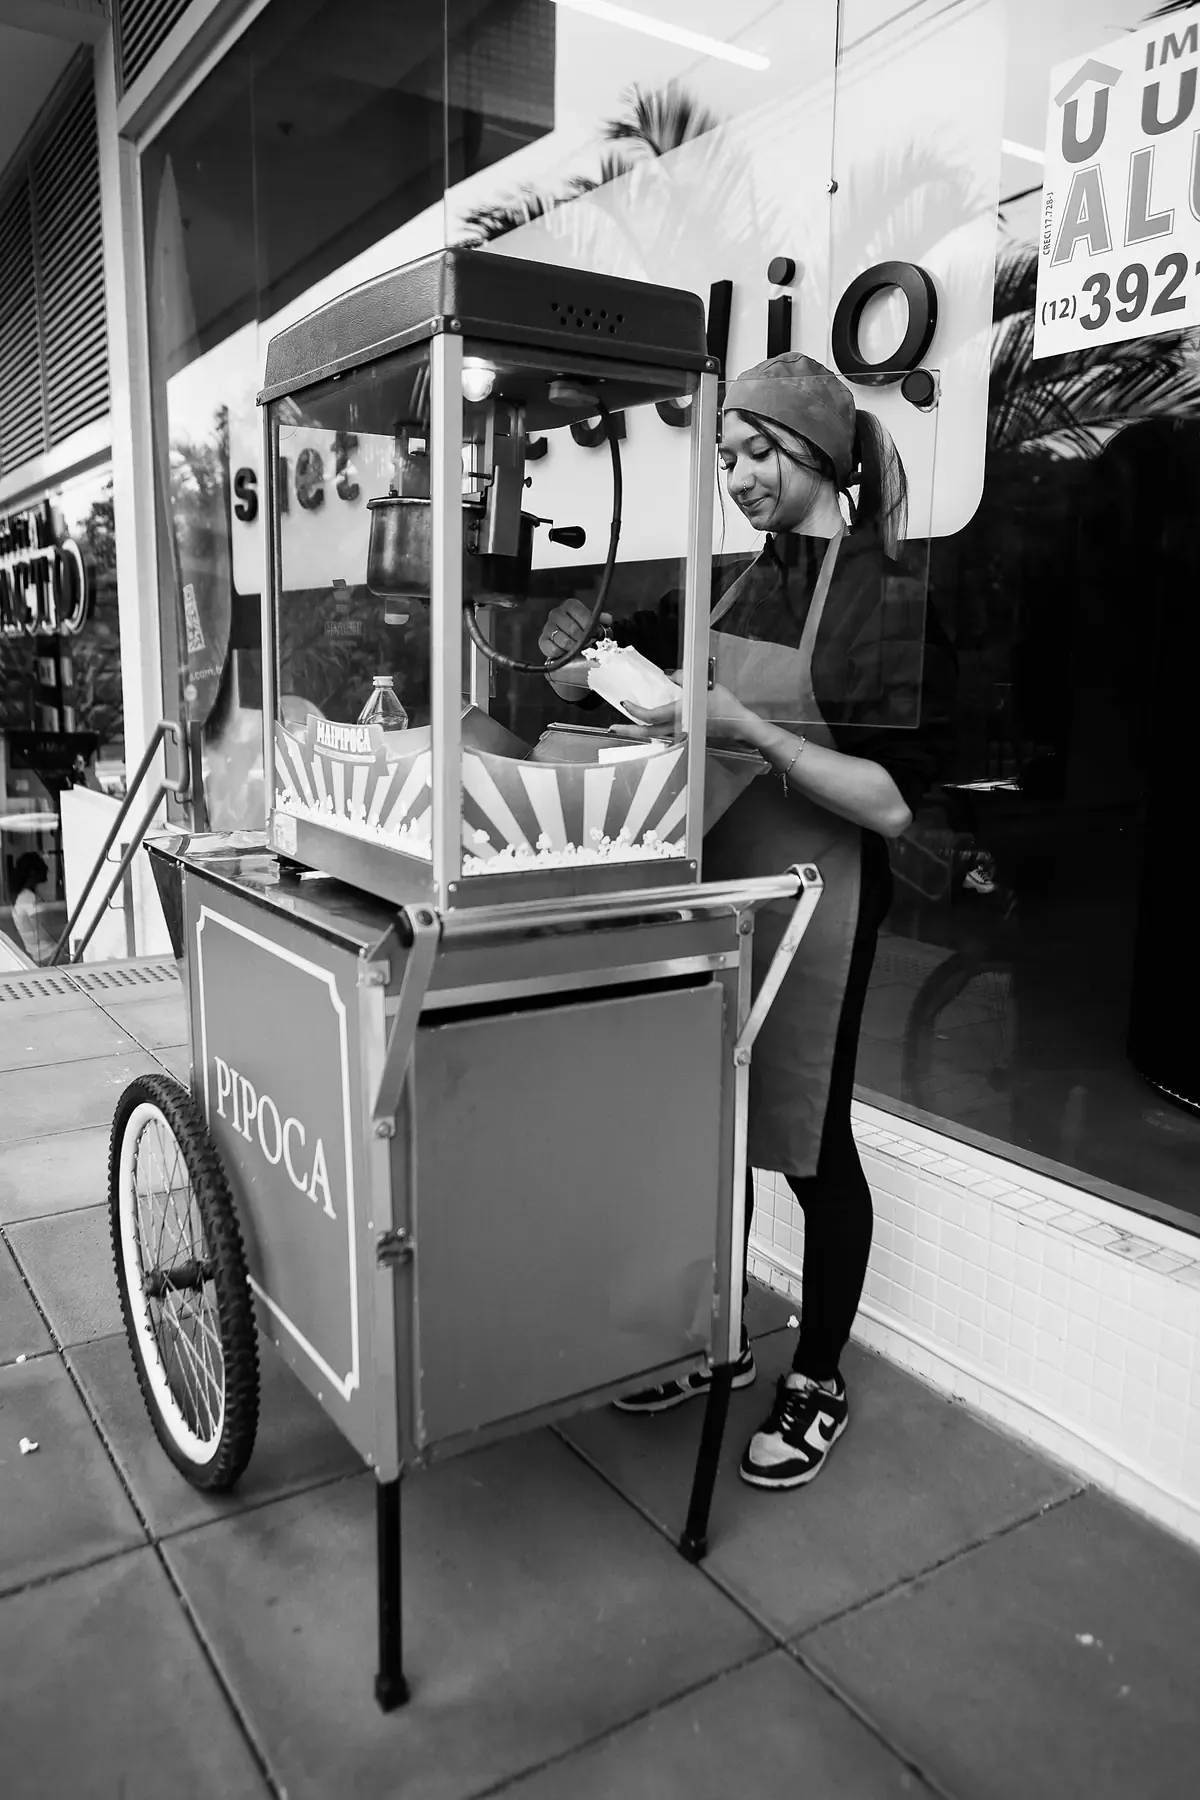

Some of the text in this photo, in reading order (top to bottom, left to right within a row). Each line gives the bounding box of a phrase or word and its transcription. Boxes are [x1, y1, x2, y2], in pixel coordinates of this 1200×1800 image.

[1145, 23, 1199, 71] IM
[1050, 130, 1200, 268] AL
[1043, 230, 1052, 256] CRECI
[1042, 252, 1200, 331] (12) 392
[214, 1056, 337, 1221] PIPOCA
